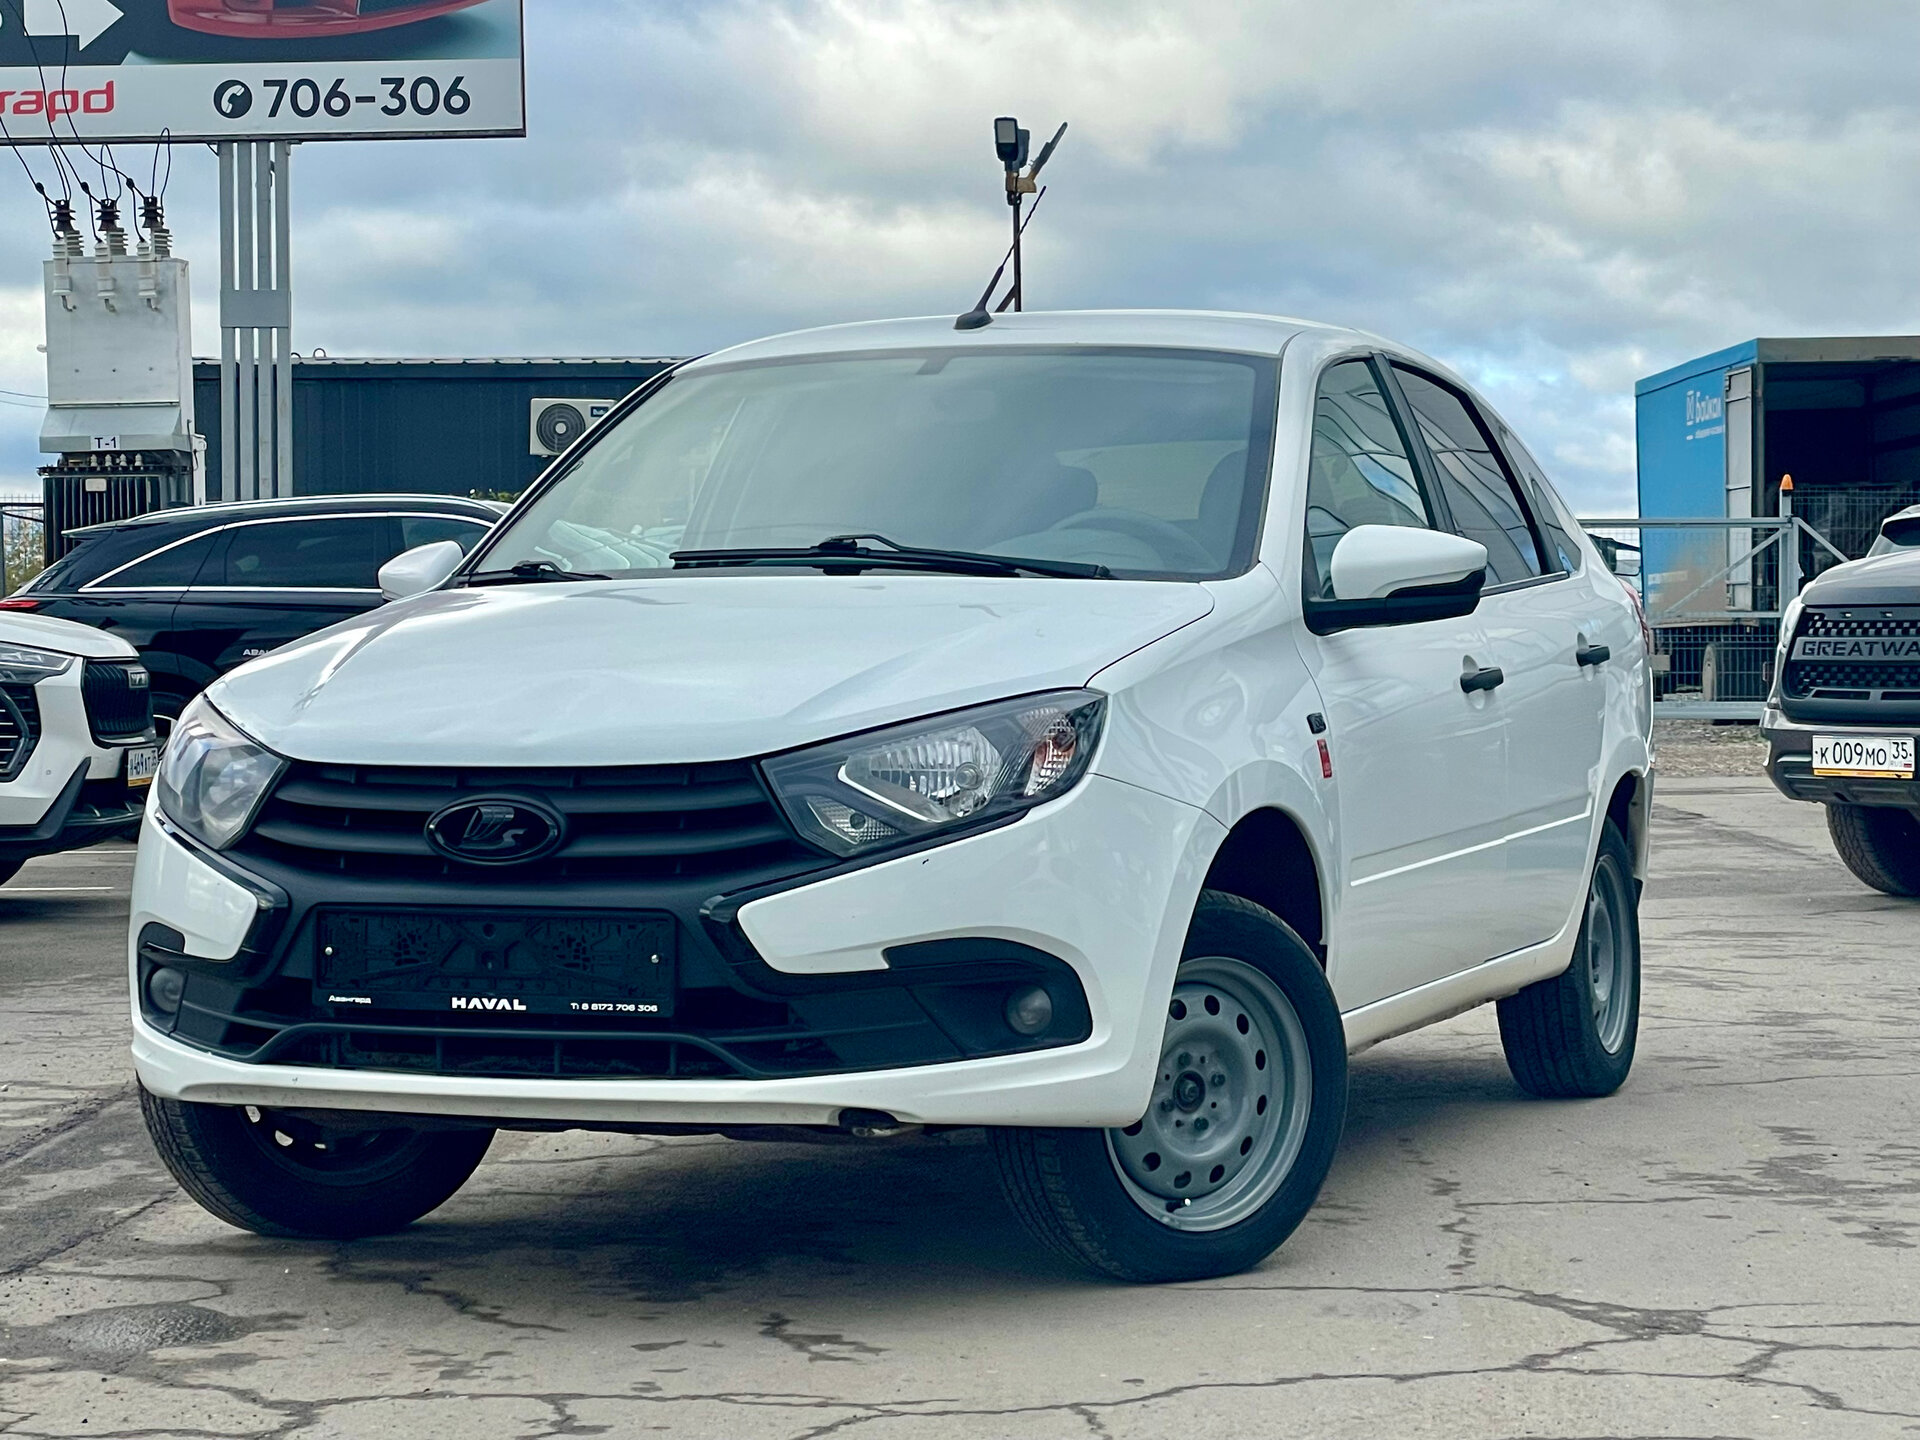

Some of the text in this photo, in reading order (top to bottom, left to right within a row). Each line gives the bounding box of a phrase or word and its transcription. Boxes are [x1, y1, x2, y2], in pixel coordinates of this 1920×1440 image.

[263, 76, 471, 118] 706-306
[1892, 741, 1908, 760] 35
[451, 996, 527, 1011] HAVAL
